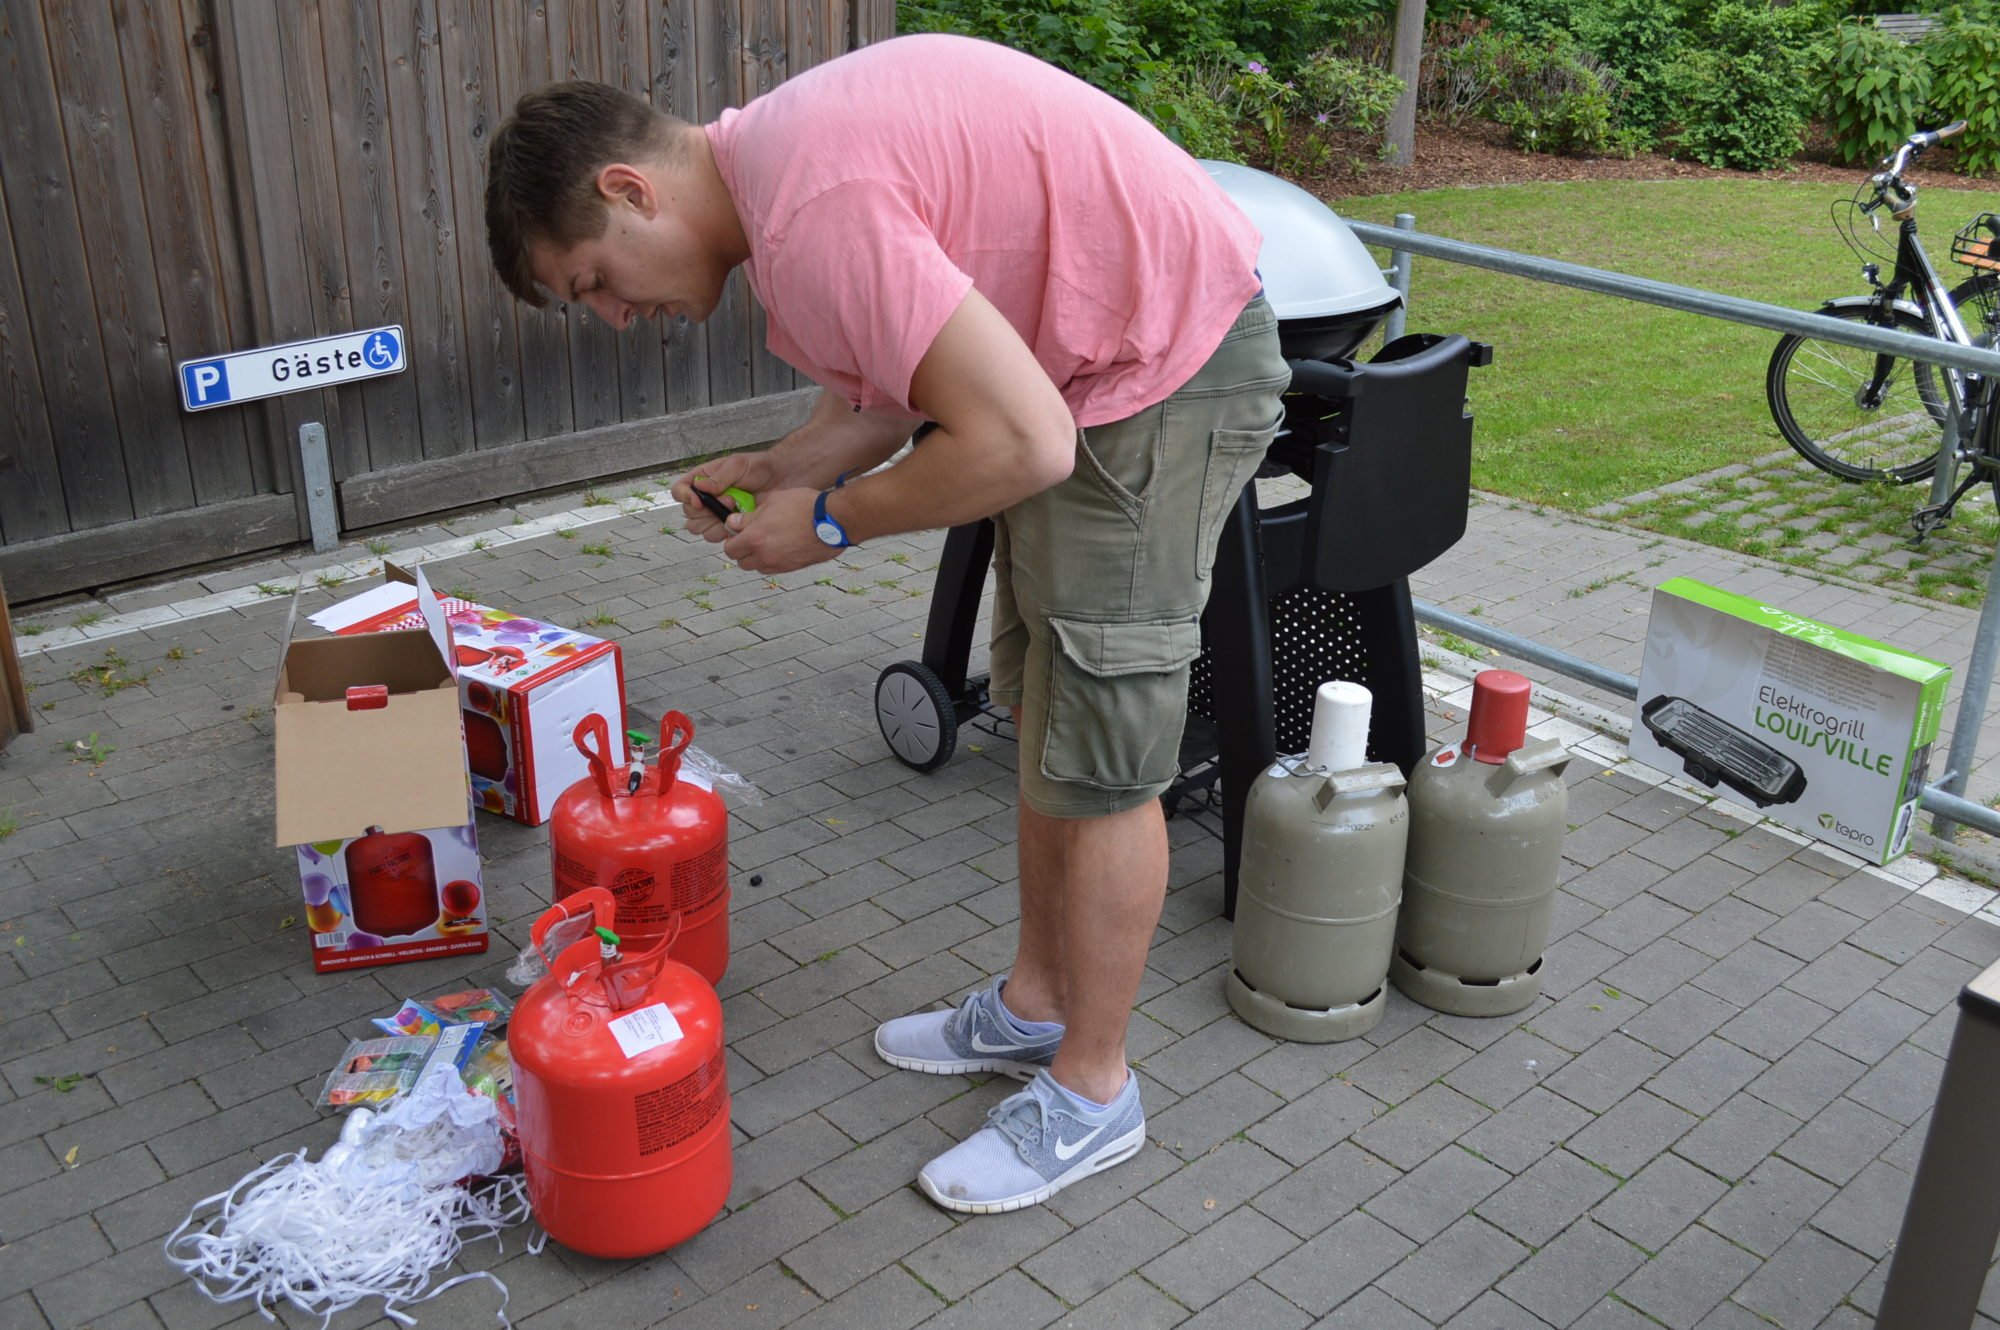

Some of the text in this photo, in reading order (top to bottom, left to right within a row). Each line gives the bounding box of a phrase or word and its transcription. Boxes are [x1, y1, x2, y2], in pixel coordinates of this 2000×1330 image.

[194, 349, 361, 401] P Gäste
[1759, 685, 1864, 741] Elektrogrill
[1755, 706, 1893, 777] LOUISVILLE
[1835, 820, 1874, 846] tepro
[629, 875, 655, 892] FACTORY
